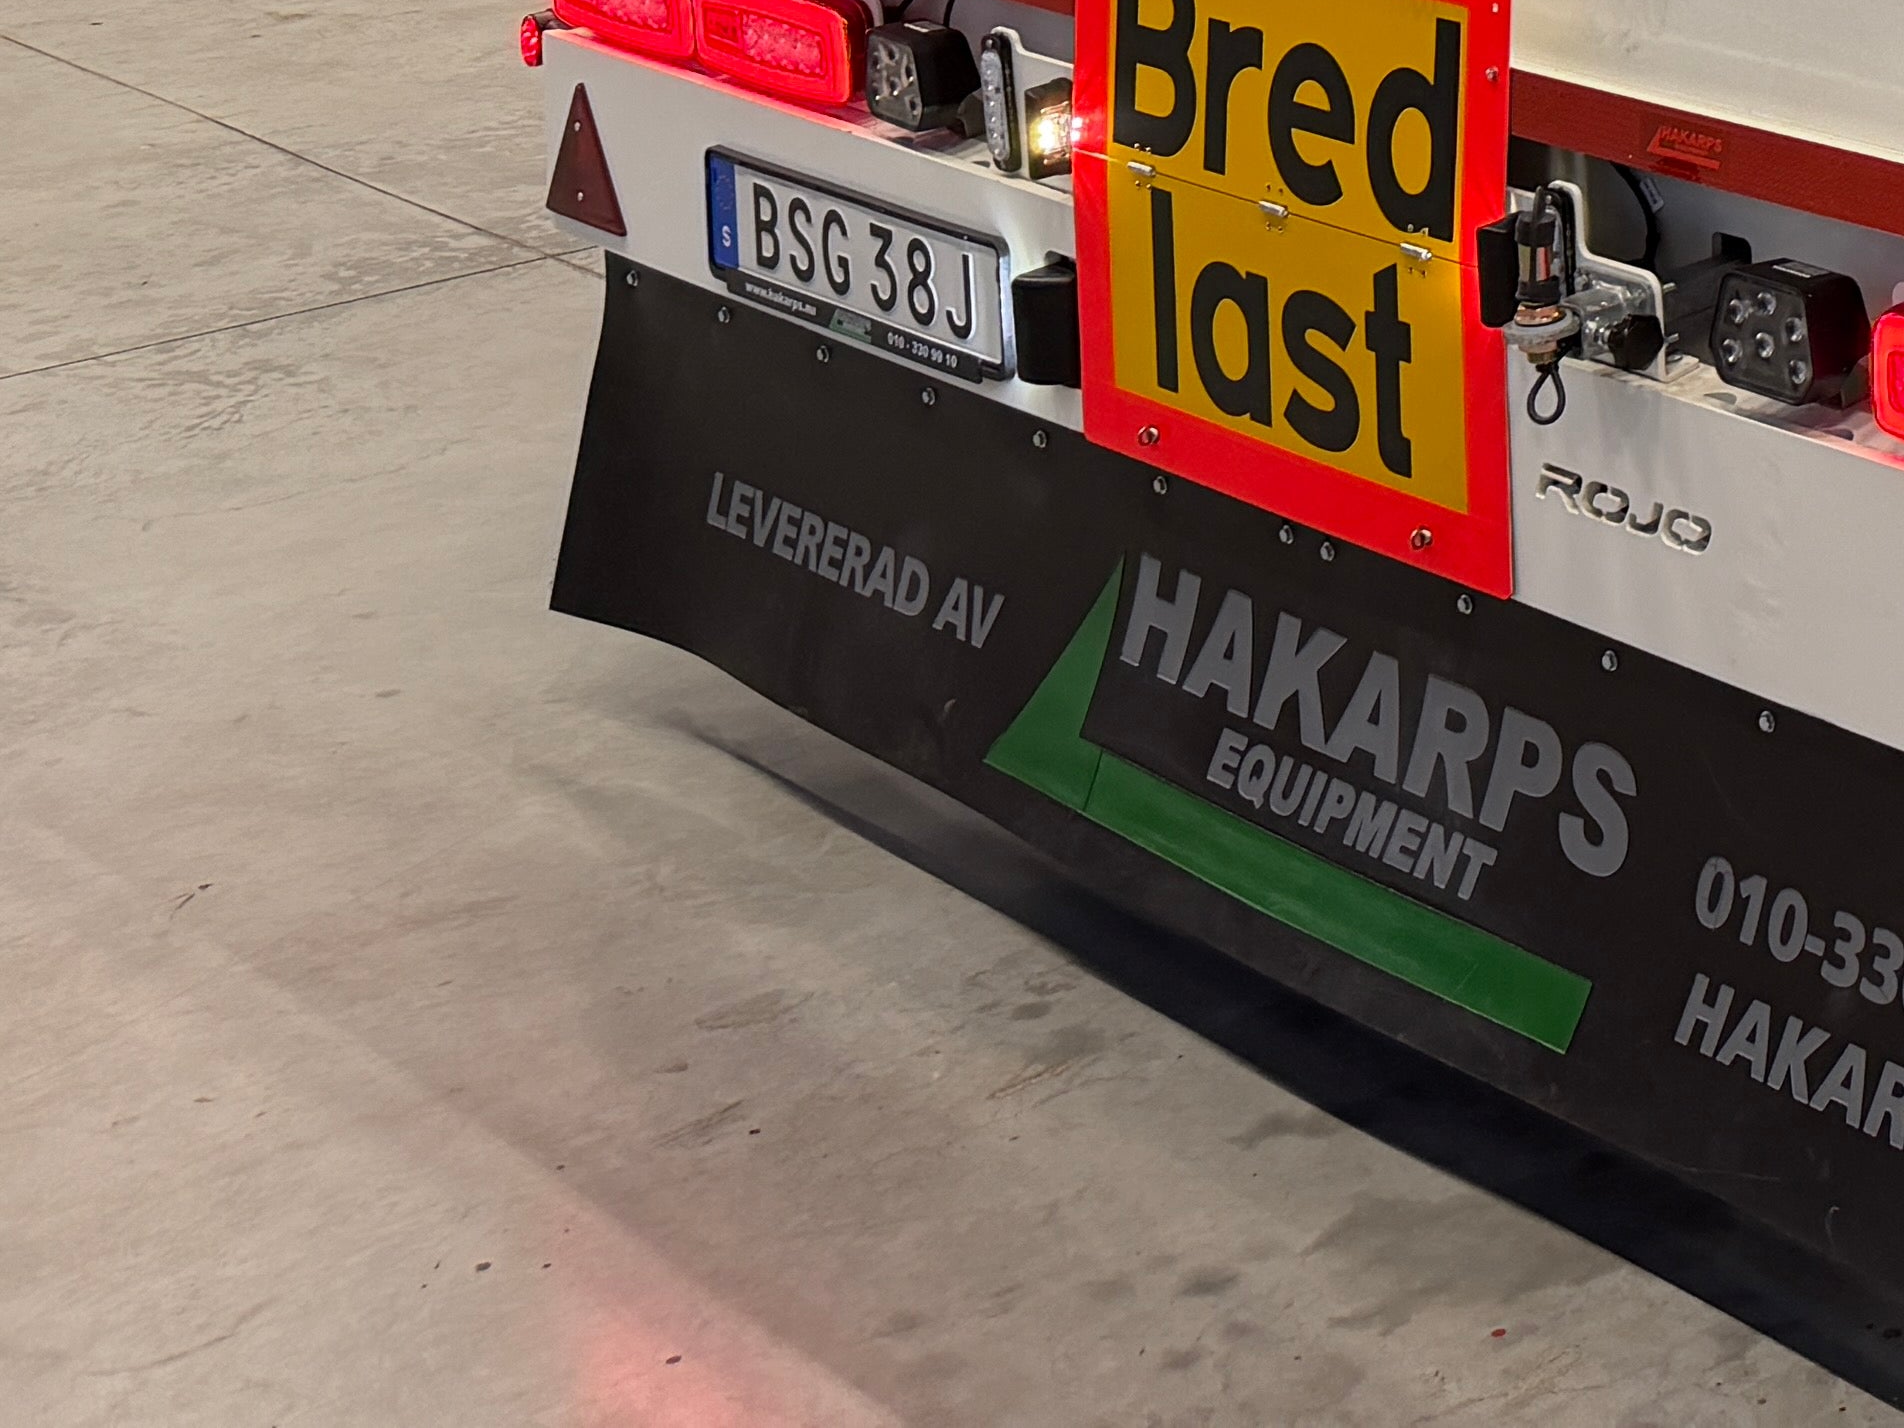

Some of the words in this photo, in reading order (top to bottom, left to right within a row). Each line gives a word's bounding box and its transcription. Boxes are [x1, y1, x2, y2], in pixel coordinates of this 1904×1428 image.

[1660, 125, 1723, 153] HAKARPS
[721, 224, 731, 247] S
[753, 181, 850, 296] BSG
[869, 222, 972, 340] 38J
[1150, 187, 1413, 479] last
[705, 470, 930, 617] LEVERERAD
[932, 573, 1005, 650] AV
[1535, 462, 1713, 556] ROJO
[1119, 550, 1638, 878] HAKARPS
[1206, 730, 1498, 900] EQUIPMENT
